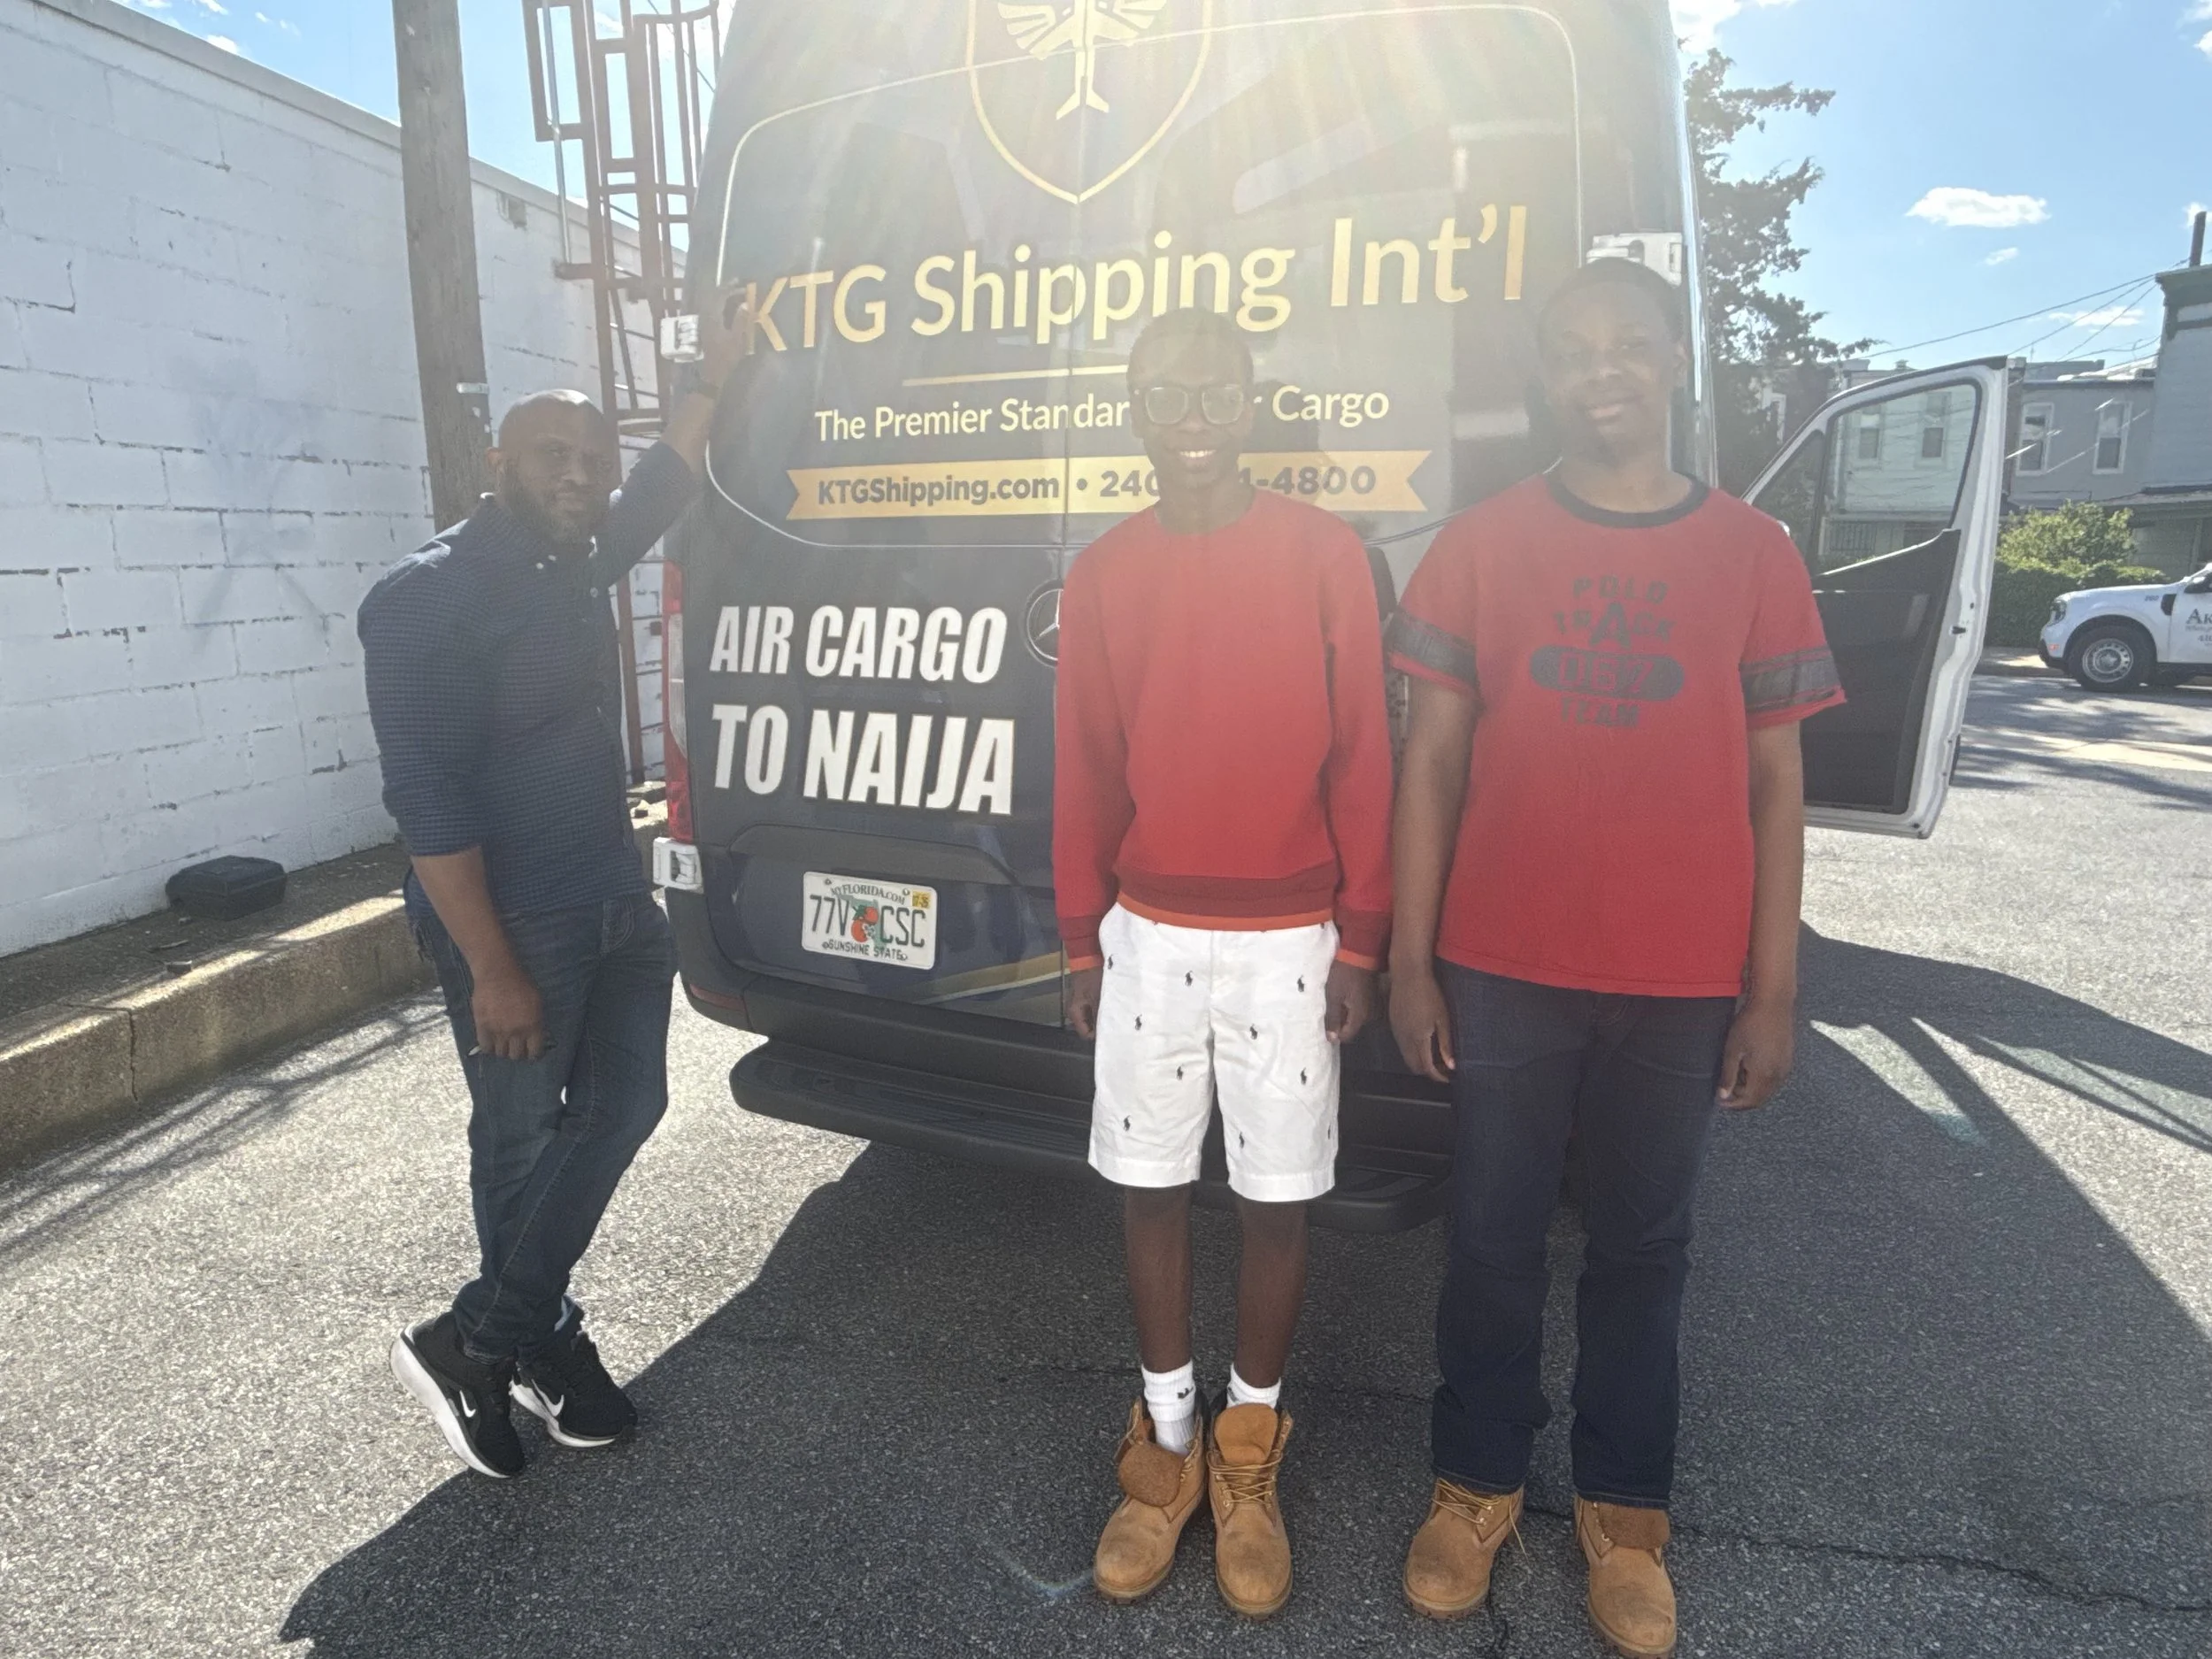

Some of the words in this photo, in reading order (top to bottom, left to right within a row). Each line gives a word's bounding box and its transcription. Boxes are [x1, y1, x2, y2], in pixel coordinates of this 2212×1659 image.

[745, 263, 887, 356] KTG
[910, 229, 1297, 345] Shipping
[1330, 204, 1527, 307] Int'l
[814, 408, 866, 442] The
[874, 400, 992, 438] Premier
[1000, 392, 1130, 434] Standar
[1271, 384, 1390, 428] Cargo
[818, 472, 1060, 509] KTGShipping.com
[1572, 573, 1670, 604] POLO
[710, 605, 795, 675] AIR
[804, 605, 1008, 684] CARGO
[1551, 601, 1678, 650] TRACK
[1560, 695, 1640, 727] TEAM
[711, 703, 789, 795] TO
[803, 709, 1015, 816] NAIJA
[810, 894, 850, 936] 77V
[879, 905, 926, 949] CSC
[828, 939, 870, 956] SUNSHINE
[873, 946, 902, 961] STATE
